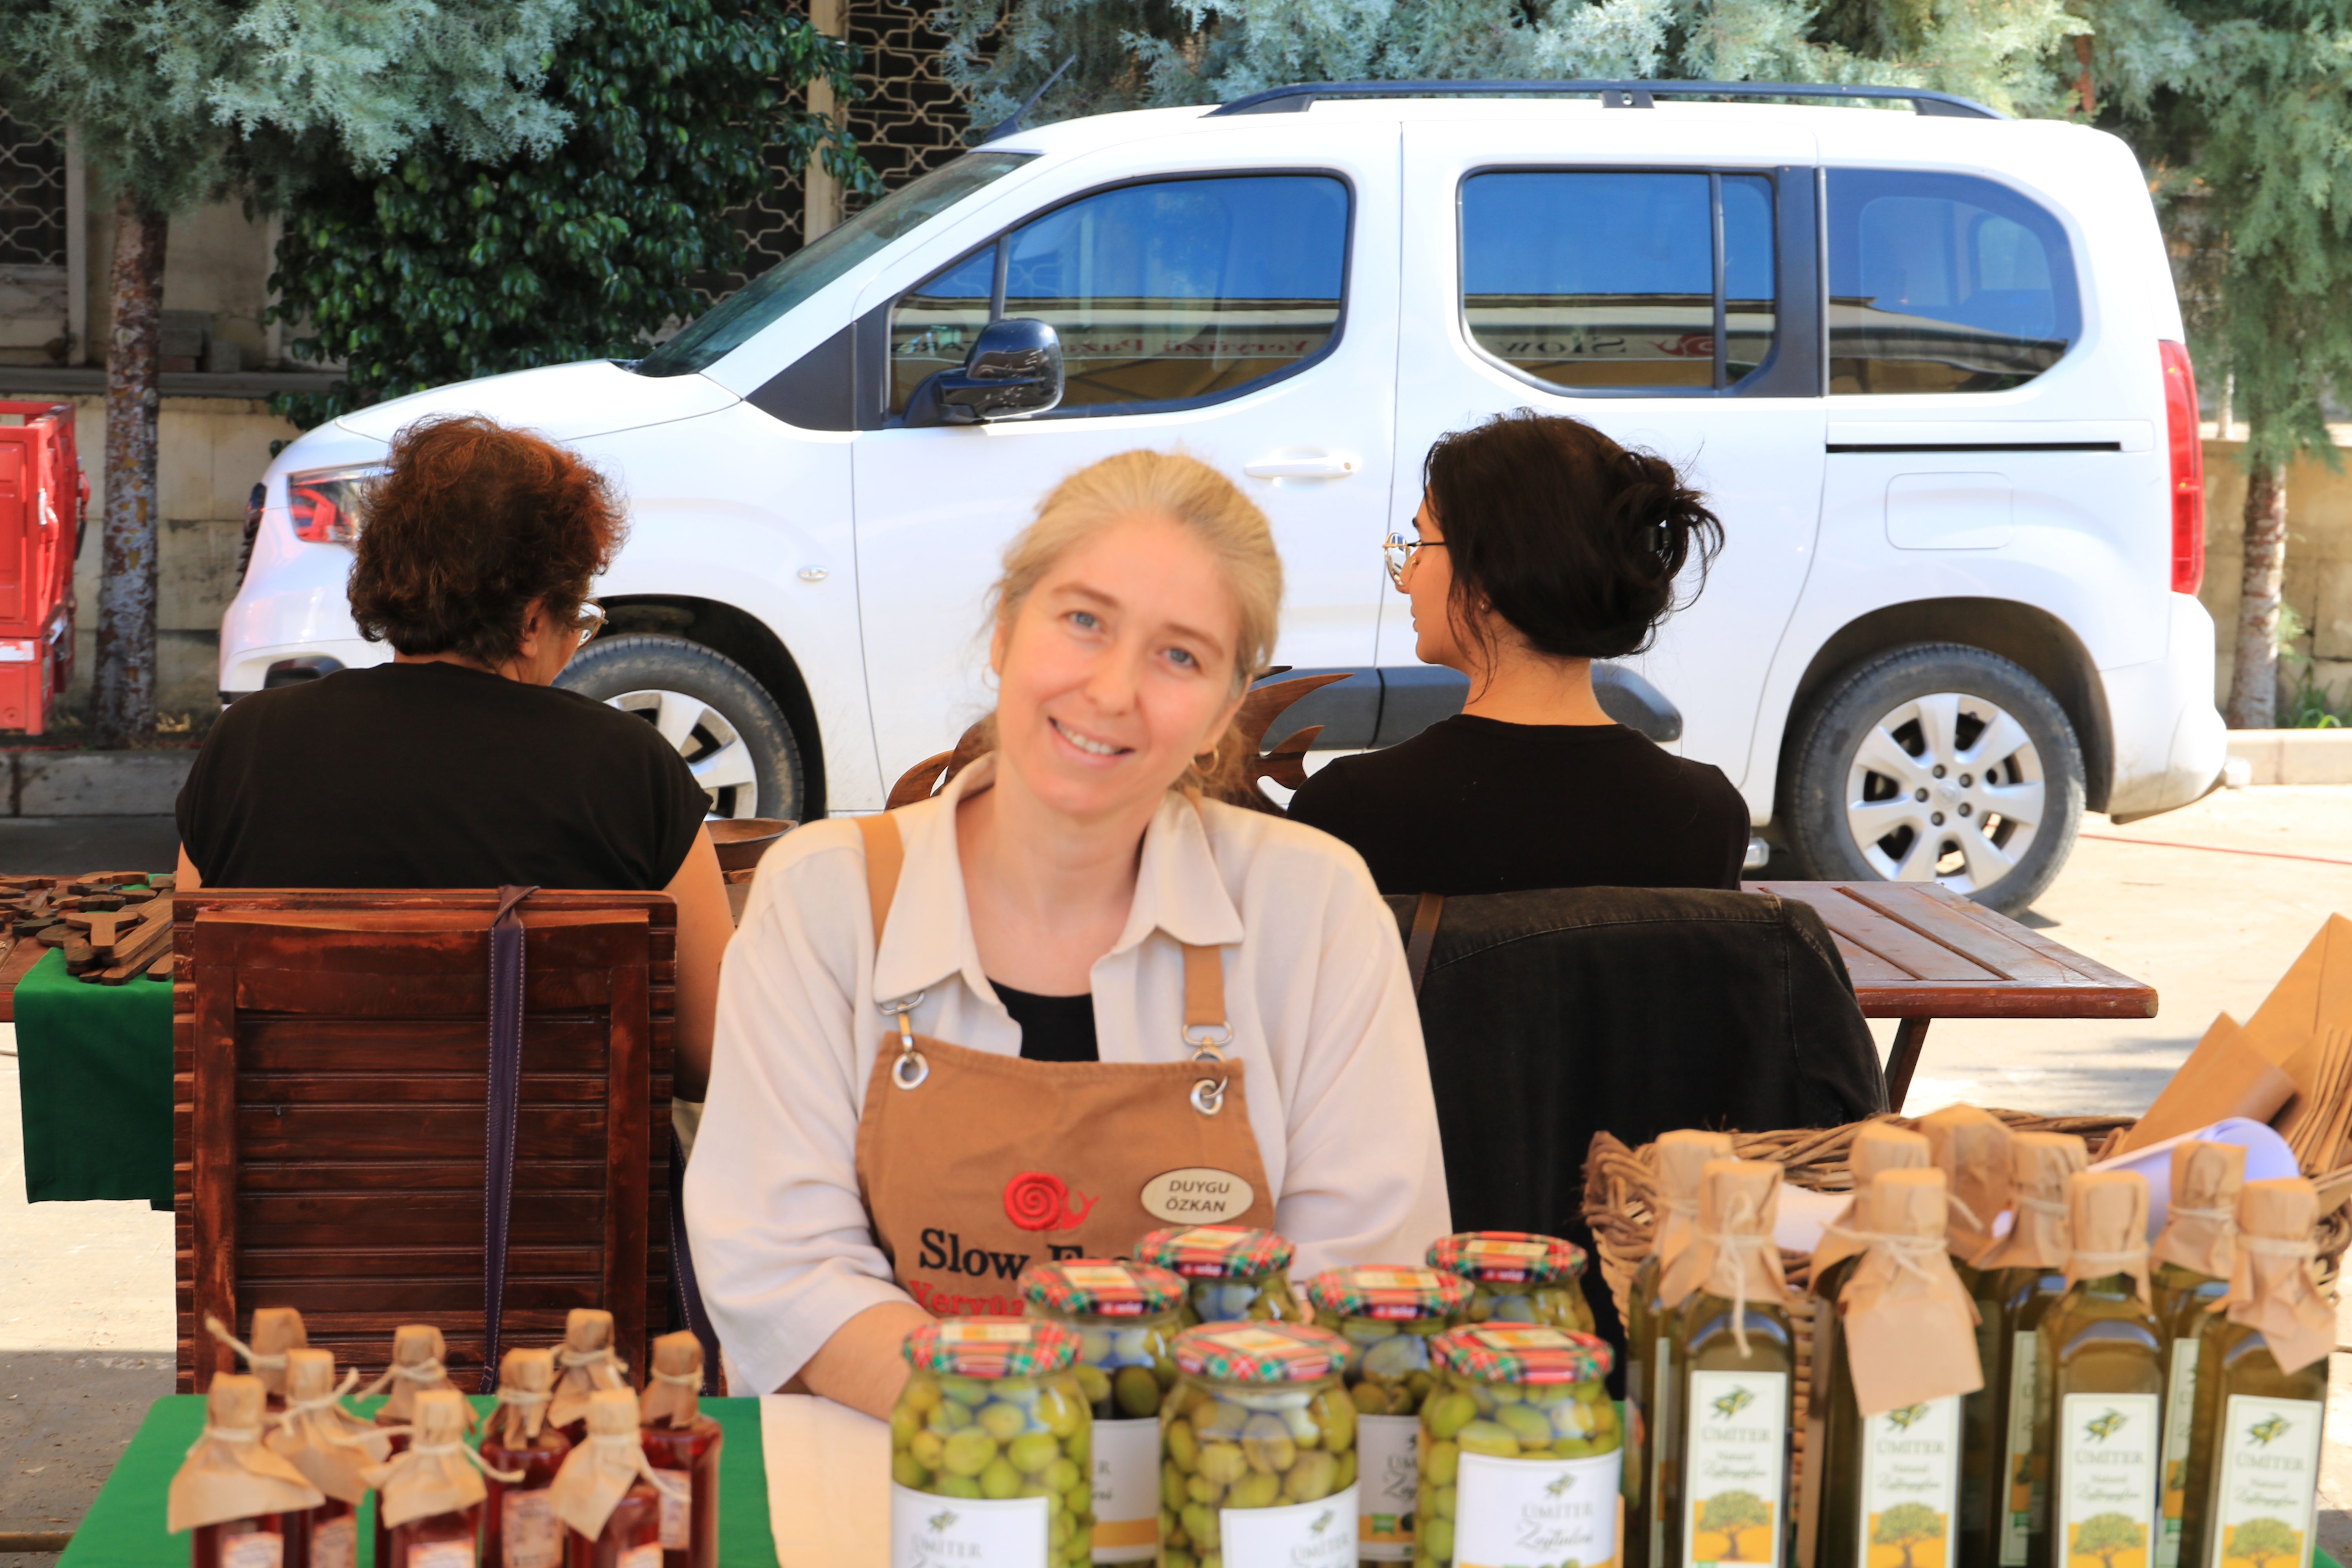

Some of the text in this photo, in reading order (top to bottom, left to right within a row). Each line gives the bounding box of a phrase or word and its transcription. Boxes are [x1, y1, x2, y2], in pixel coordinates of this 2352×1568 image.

[1169, 1180, 1231, 1195] DUYGU
[1165, 1196, 1227, 1214] ÖZKAN
[919, 1228, 1030, 1281] Slow
[908, 1279, 1025, 1316] Yeryüz
